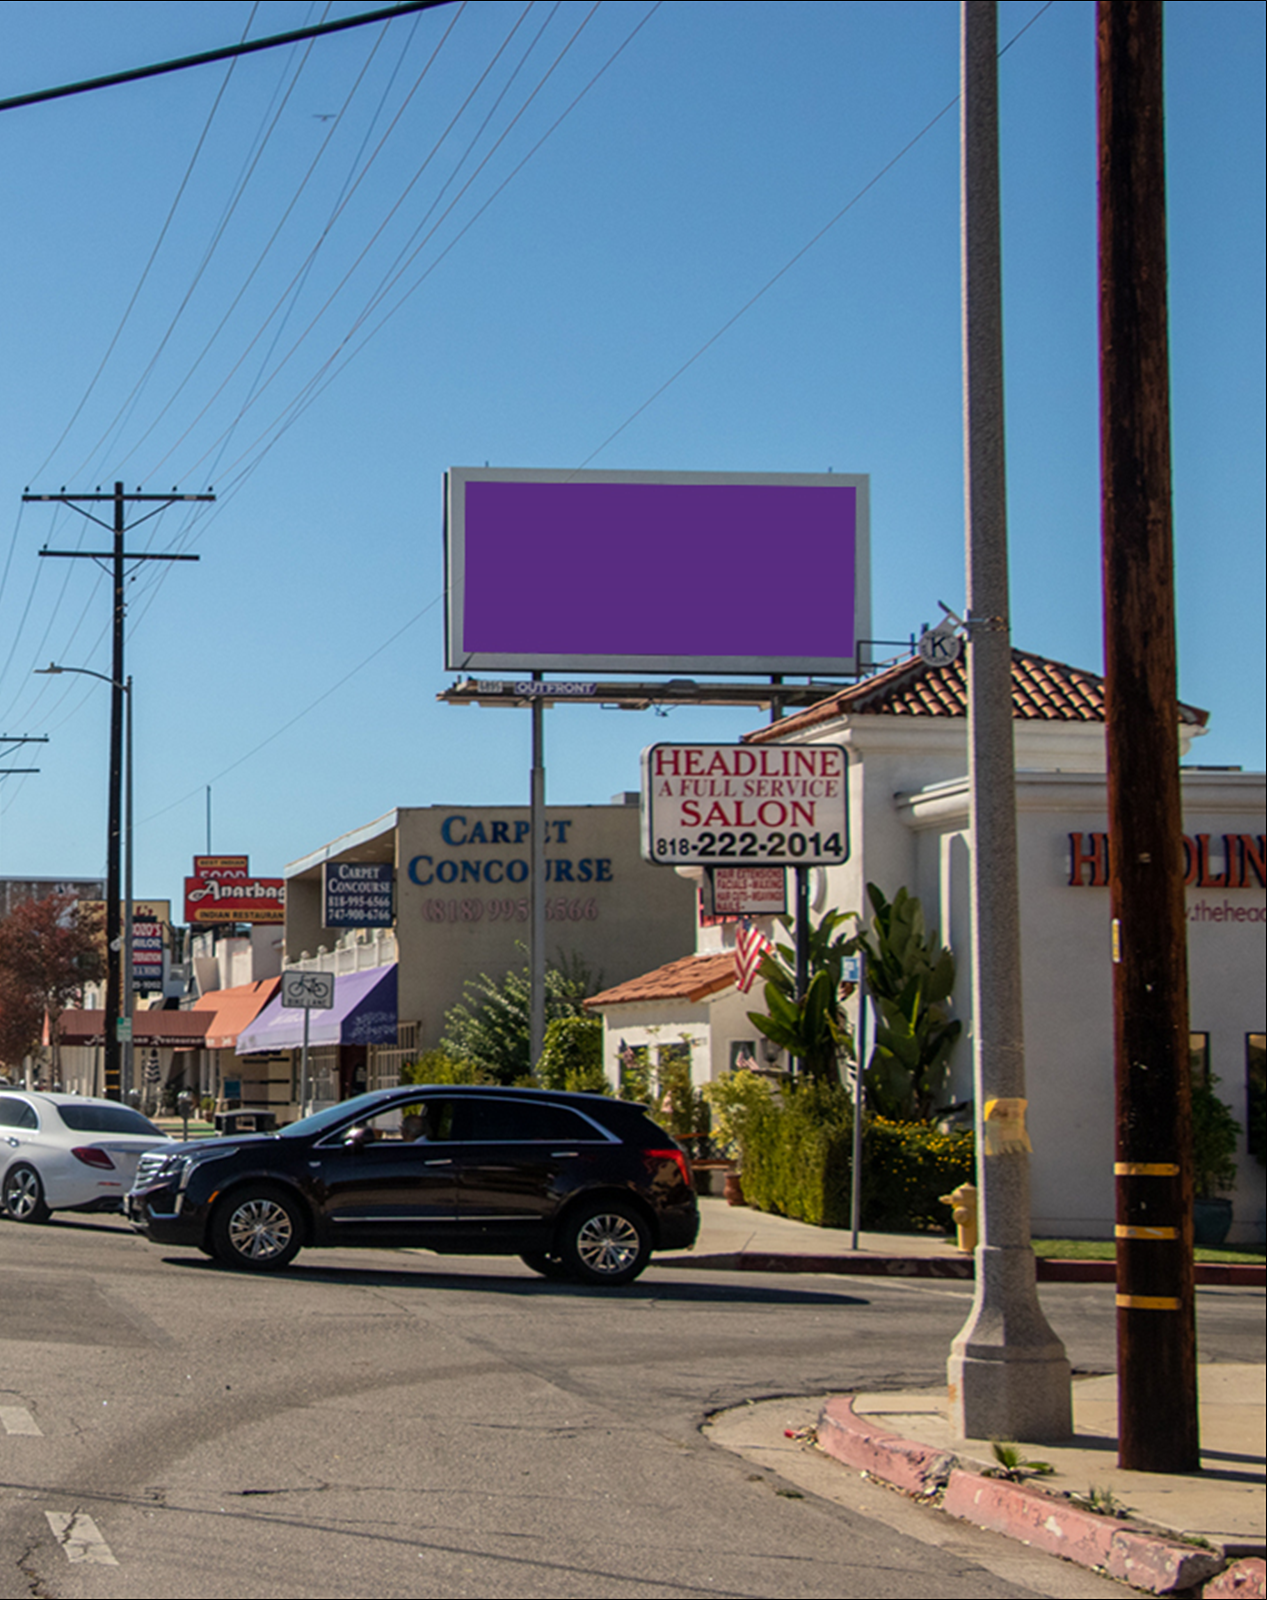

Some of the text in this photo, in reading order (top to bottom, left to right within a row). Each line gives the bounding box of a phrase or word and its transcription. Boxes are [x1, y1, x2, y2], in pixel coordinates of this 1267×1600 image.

[930, 636, 948, 658] K
[516, 682, 594, 694] OUTFRONT
[654, 750, 841, 777] HEADLINE
[658, 780, 839, 798] A FULL SERVICE
[680, 800, 817, 828] SALON
[440, 815, 572, 846] CARPT
[656, 832, 843, 857] 818-222-2014
[338, 864, 381, 879] CARPET
[1068, 833, 1266, 888] HDLIN
[187, 879, 285, 905] Anarbag
[328, 877, 391, 893] CONCOURSE
[329, 895, 391, 907] 818-995-6566
[421, 899, 484, 923] (818)
